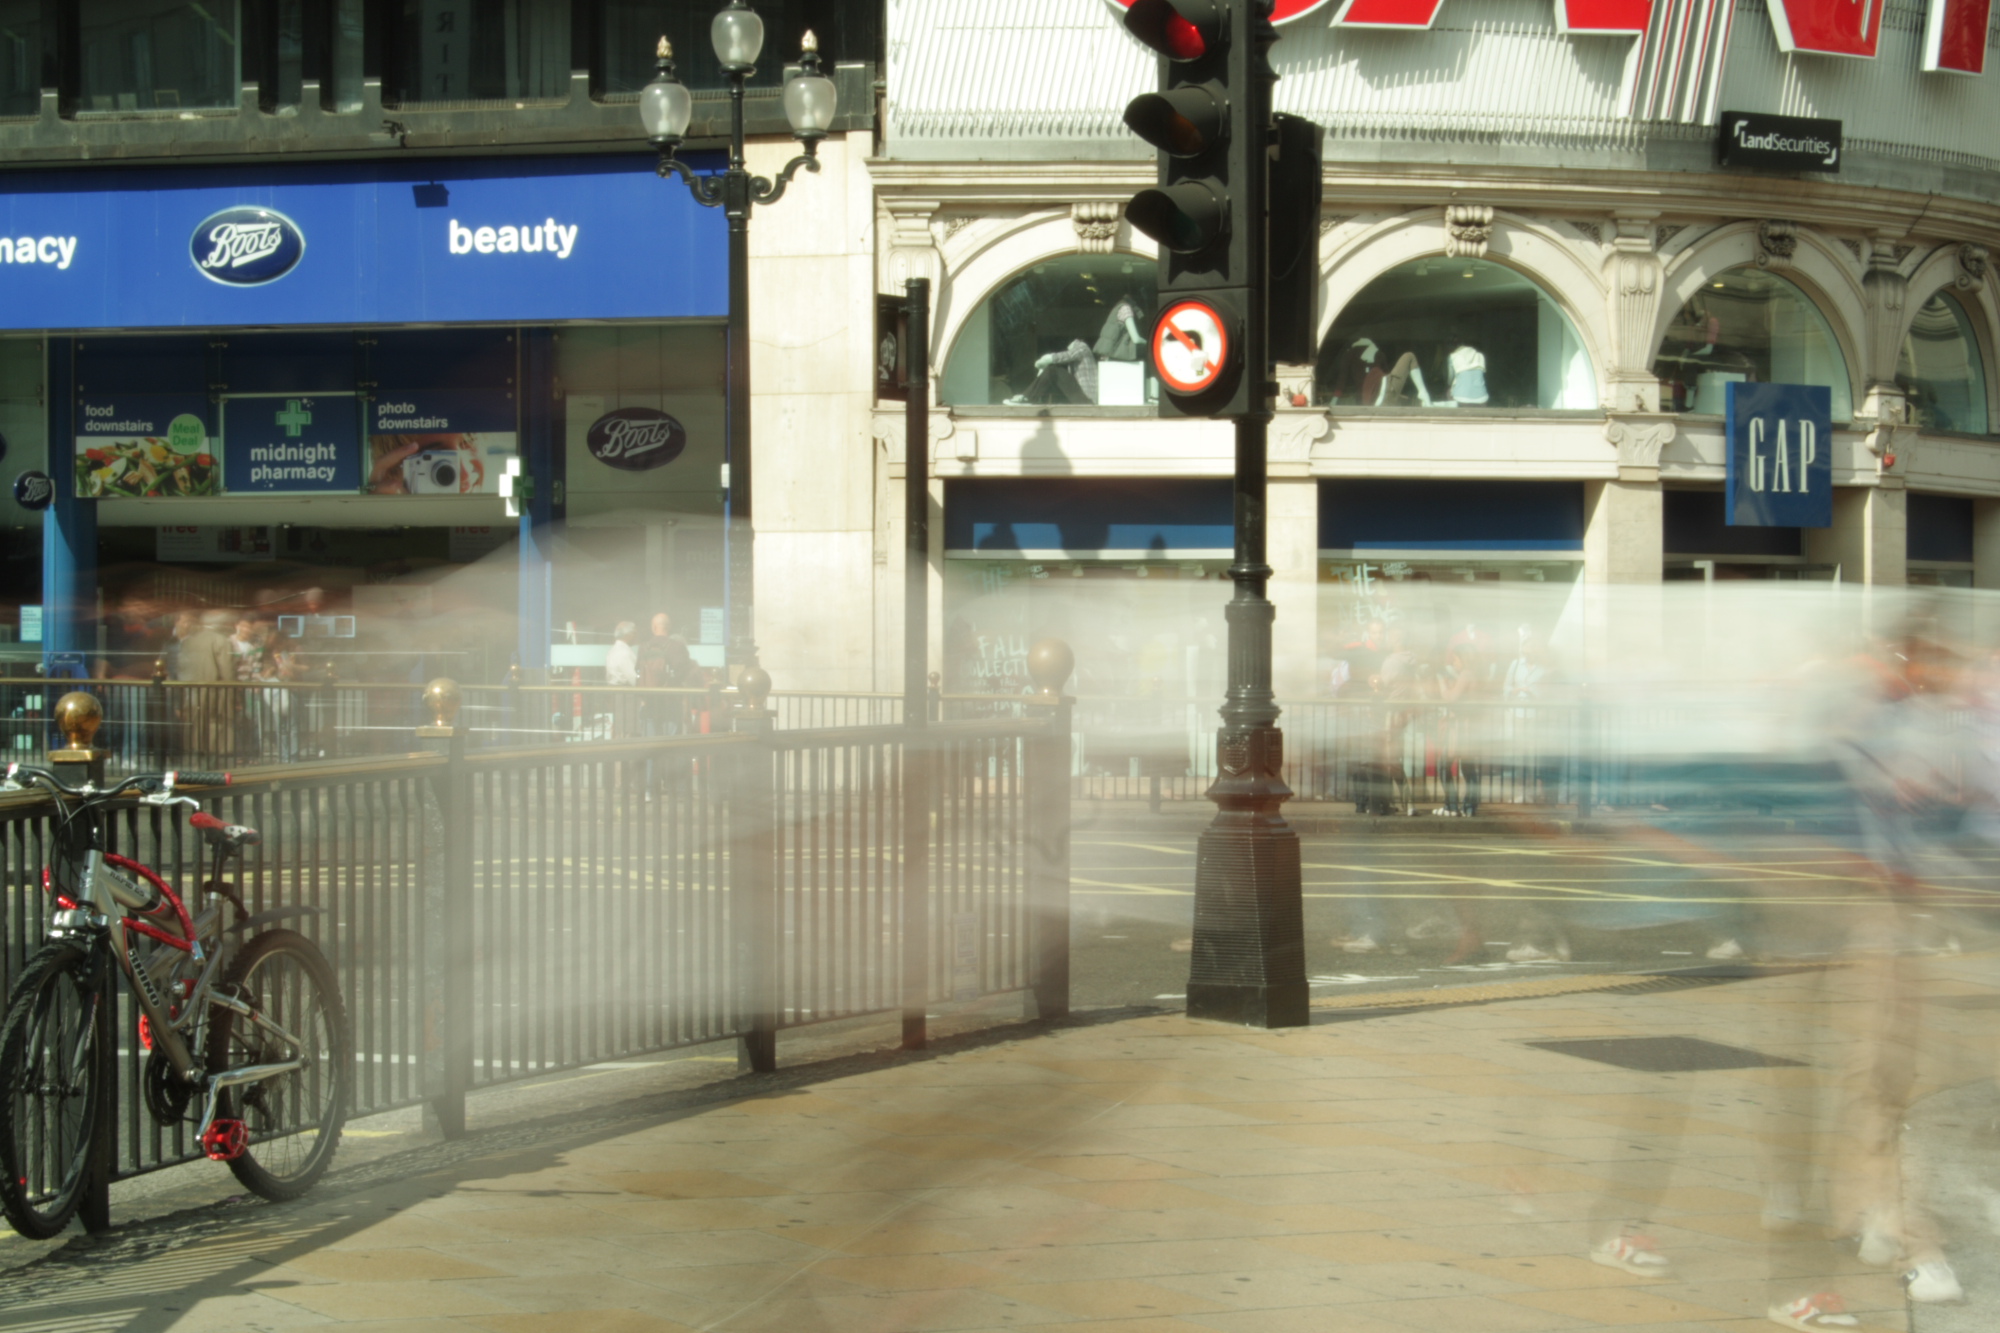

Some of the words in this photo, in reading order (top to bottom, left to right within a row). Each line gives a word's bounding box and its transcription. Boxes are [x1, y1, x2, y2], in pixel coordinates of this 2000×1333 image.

[1740, 131, 1830, 154] LandSecurities
[202, 222, 282, 268] Boots
[449, 218, 578, 259] beauty
[85, 405, 114, 416] food
[378, 402, 416, 416] photo
[85, 420, 154, 432] downstairs
[172, 423, 200, 434] Meal
[378, 417, 448, 429] downstairs
[172, 435, 198, 446] Deal
[596, 419, 671, 459] Boots
[250, 443, 336, 464] midnight
[1749, 417, 1816, 493] GAP
[251, 464, 336, 483] pharmacy
[976, 633, 1030, 660] FALL
